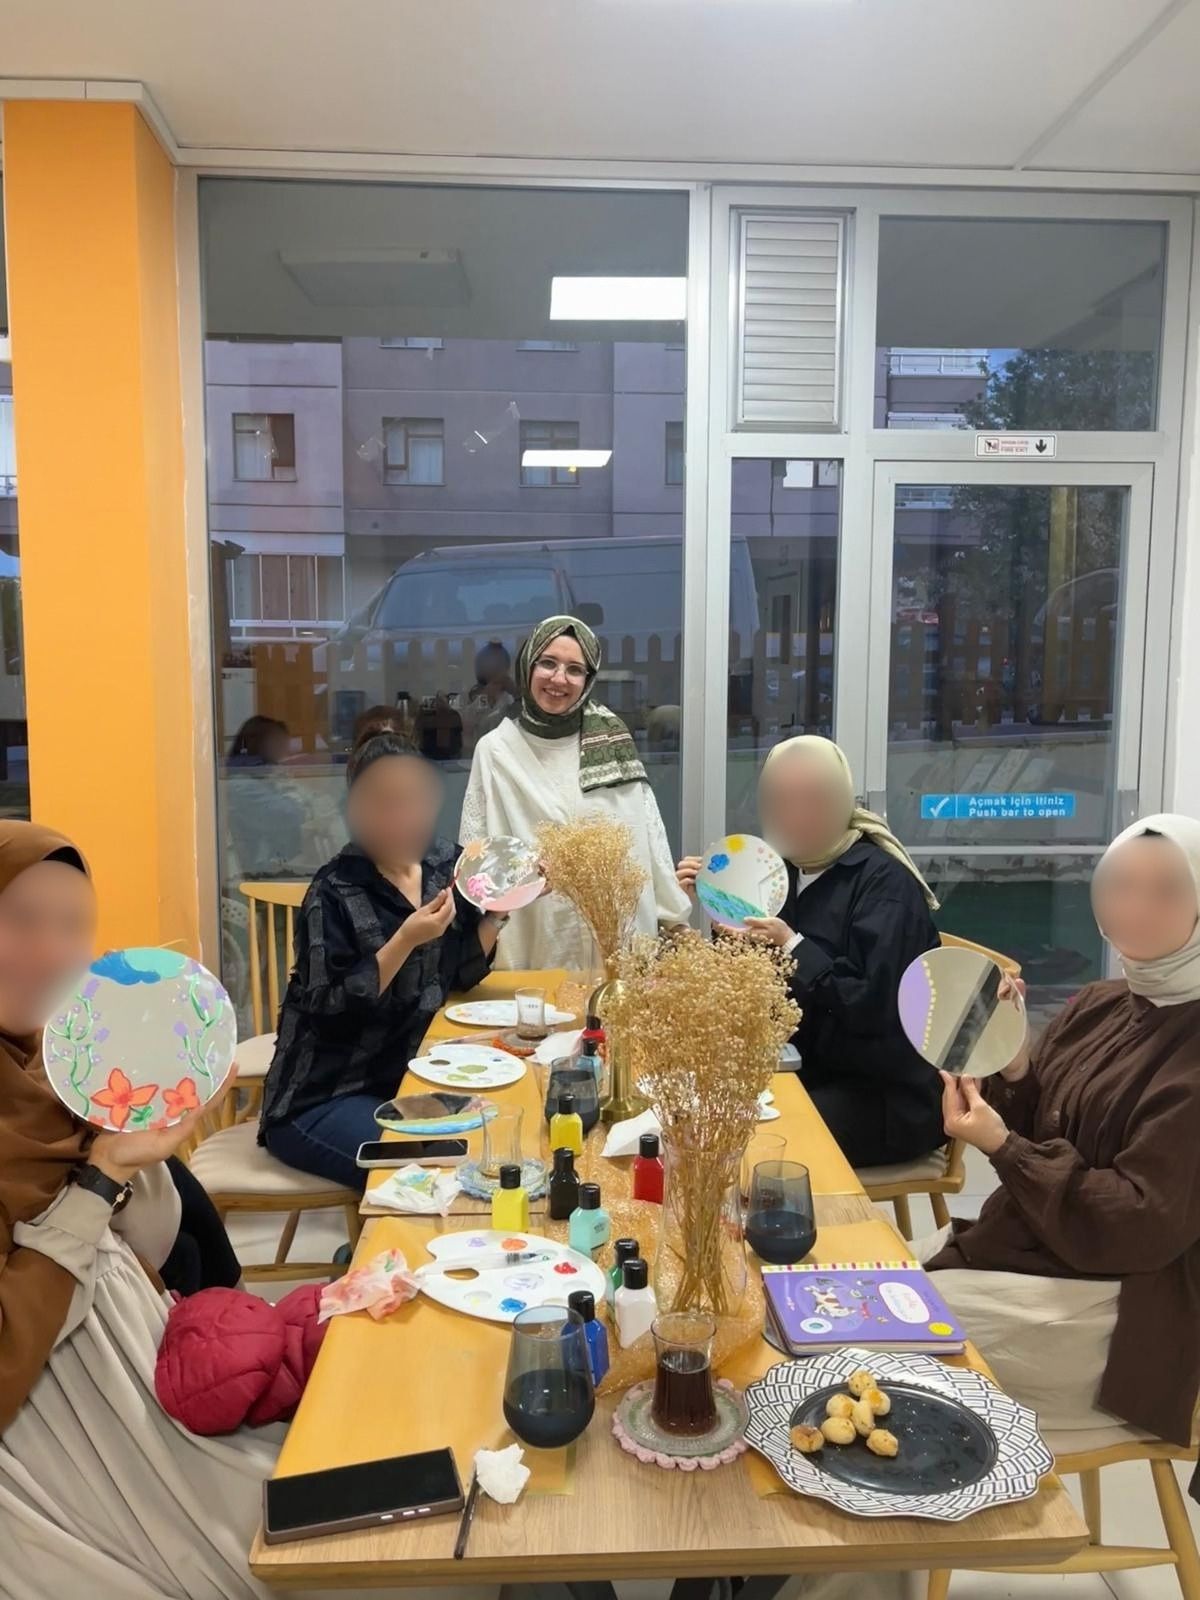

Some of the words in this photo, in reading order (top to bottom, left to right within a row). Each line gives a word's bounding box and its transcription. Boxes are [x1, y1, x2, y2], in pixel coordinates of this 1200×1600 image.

[969, 808, 997, 817] Push
[1001, 808, 1019, 817] bar
[1023, 808, 1034, 816] to
[1039, 809, 1065, 818] open
